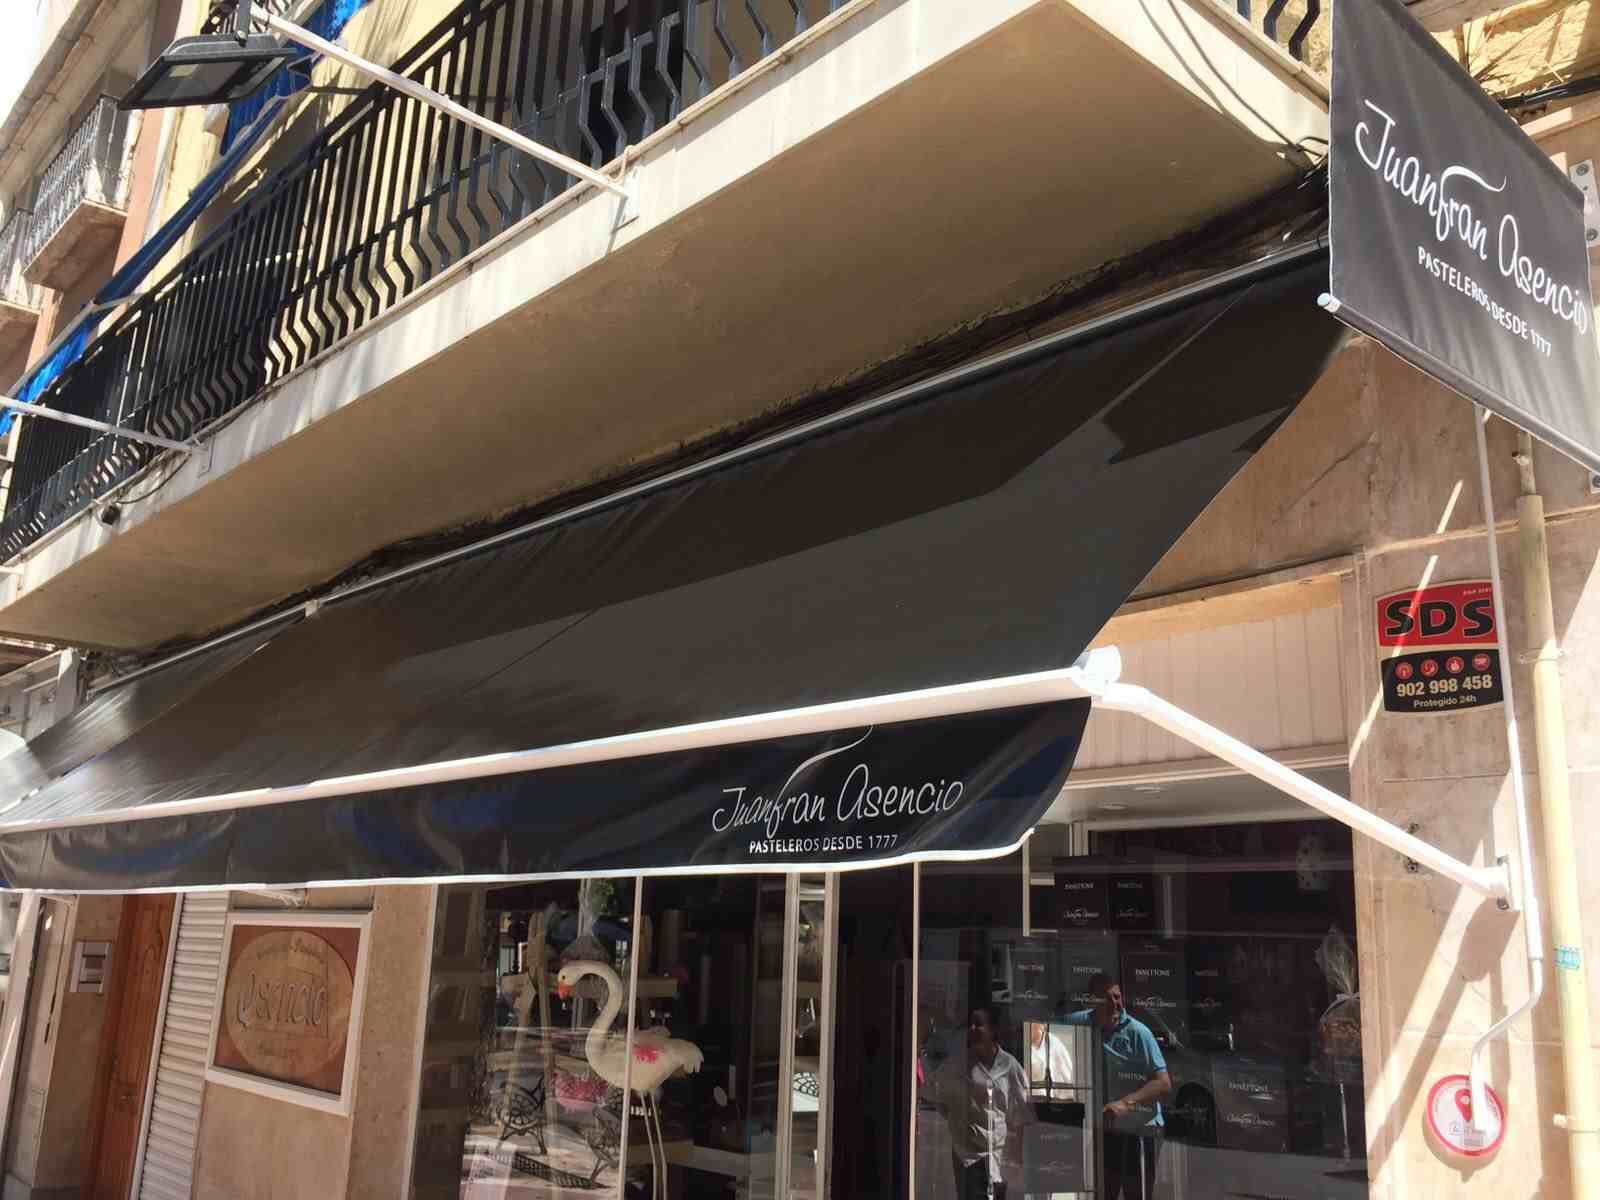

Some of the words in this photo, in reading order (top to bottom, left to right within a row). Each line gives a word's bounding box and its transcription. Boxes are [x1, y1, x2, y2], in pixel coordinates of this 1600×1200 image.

[1355, 99, 1507, 261] Juanfran
[1498, 214, 1588, 335] Asencio
[1417, 246, 1491, 313] PASTELEROS
[1491, 301, 1528, 340] DESDE
[1529, 329, 1552, 356] 1777
[1385, 598, 1496, 637] SDS
[1396, 681, 1426, 697] 902
[1429, 678, 1459, 694] 998
[1462, 674, 1493, 690] 458
[1413, 696, 1458, 709] Protegido
[1460, 695, 1477, 705] 24h
[712, 725, 874, 839] Juanfran
[836, 763, 965, 822] Asencio
[749, 837, 820, 854] PASTELEROS
[822, 835, 863, 851] DESDE
[868, 834, 899, 849] 1777
